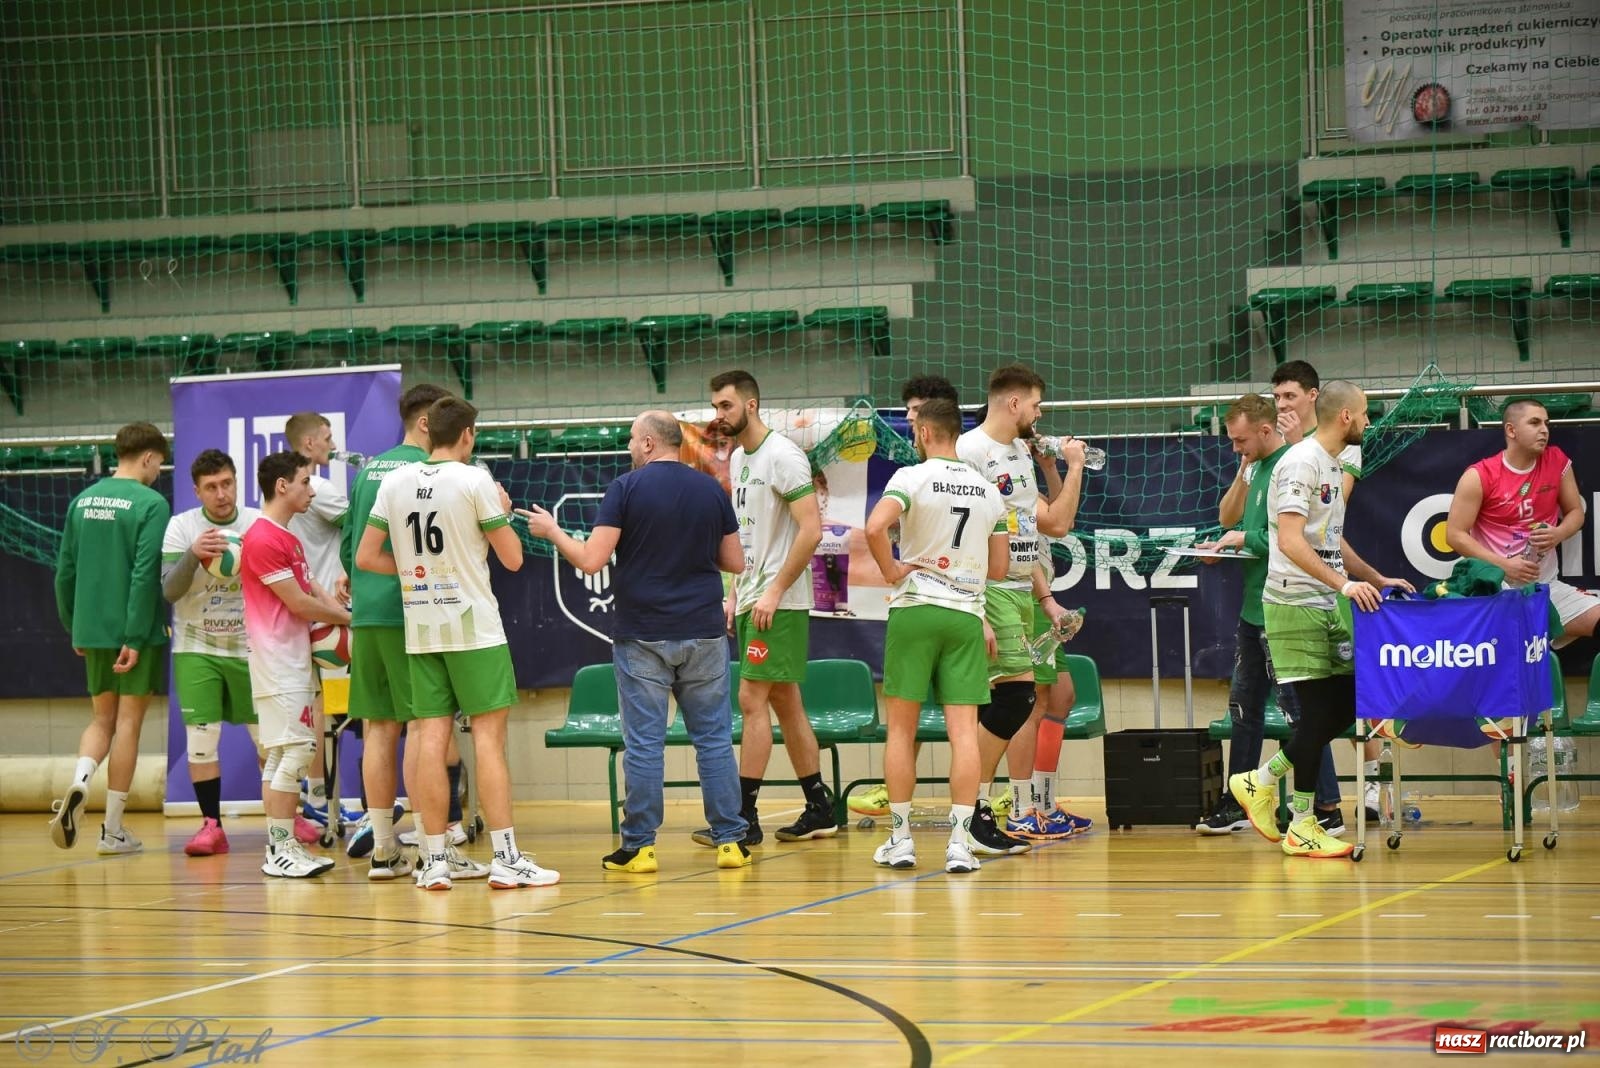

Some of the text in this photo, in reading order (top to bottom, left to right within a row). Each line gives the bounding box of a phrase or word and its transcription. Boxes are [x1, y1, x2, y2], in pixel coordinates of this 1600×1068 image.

[1381, 16, 1600, 43] Operator urządzeń cukierniczy
[1382, 35, 1546, 57] Pracownik produkcyjny
[1466, 55, 1600, 75] Czekamy na Ciebie
[736, 487, 747, 509] 14
[933, 481, 986, 498] BŁASZCZOK
[1517, 499, 1534, 519] 15
[406, 511, 444, 556] 16
[950, 506, 970, 549] 7
[1009, 542, 1034, 553] OMPY
